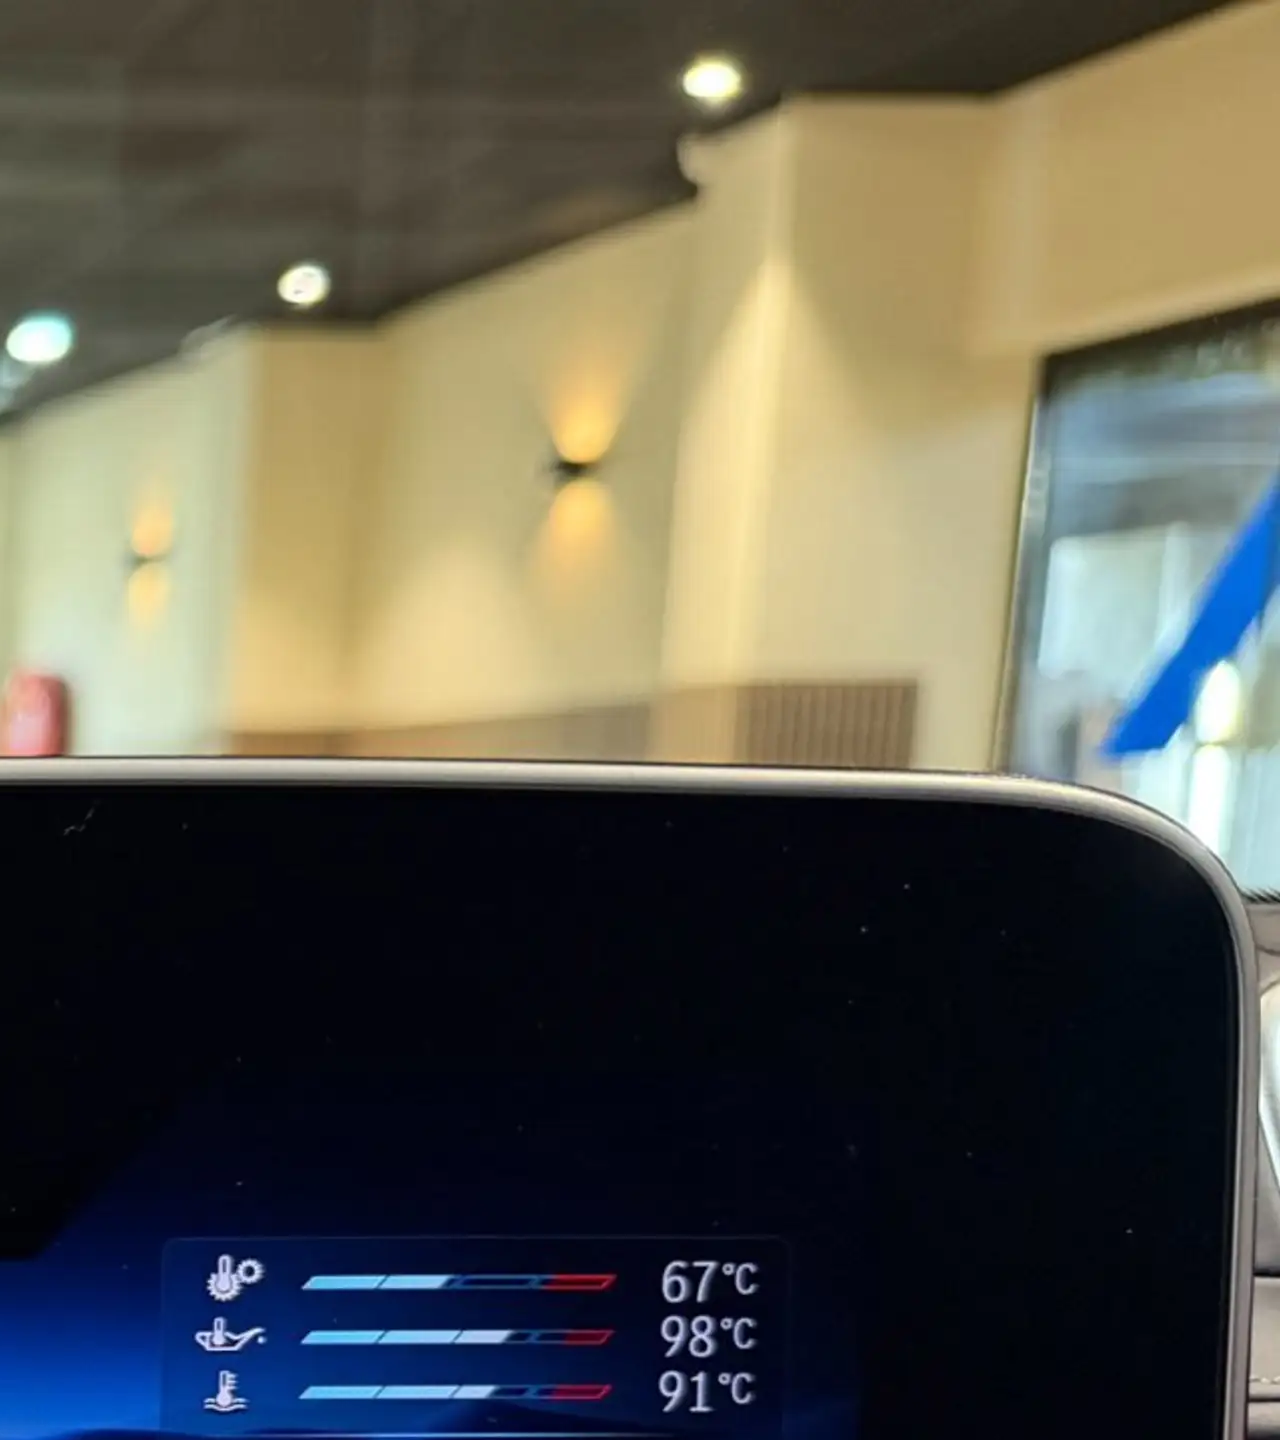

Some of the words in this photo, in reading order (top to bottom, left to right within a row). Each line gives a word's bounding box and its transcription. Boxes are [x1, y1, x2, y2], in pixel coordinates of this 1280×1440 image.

[661, 1260, 759, 1303] 67°C
[660, 1315, 757, 1358] 98°C
[658, 1371, 754, 1413] 91°C
